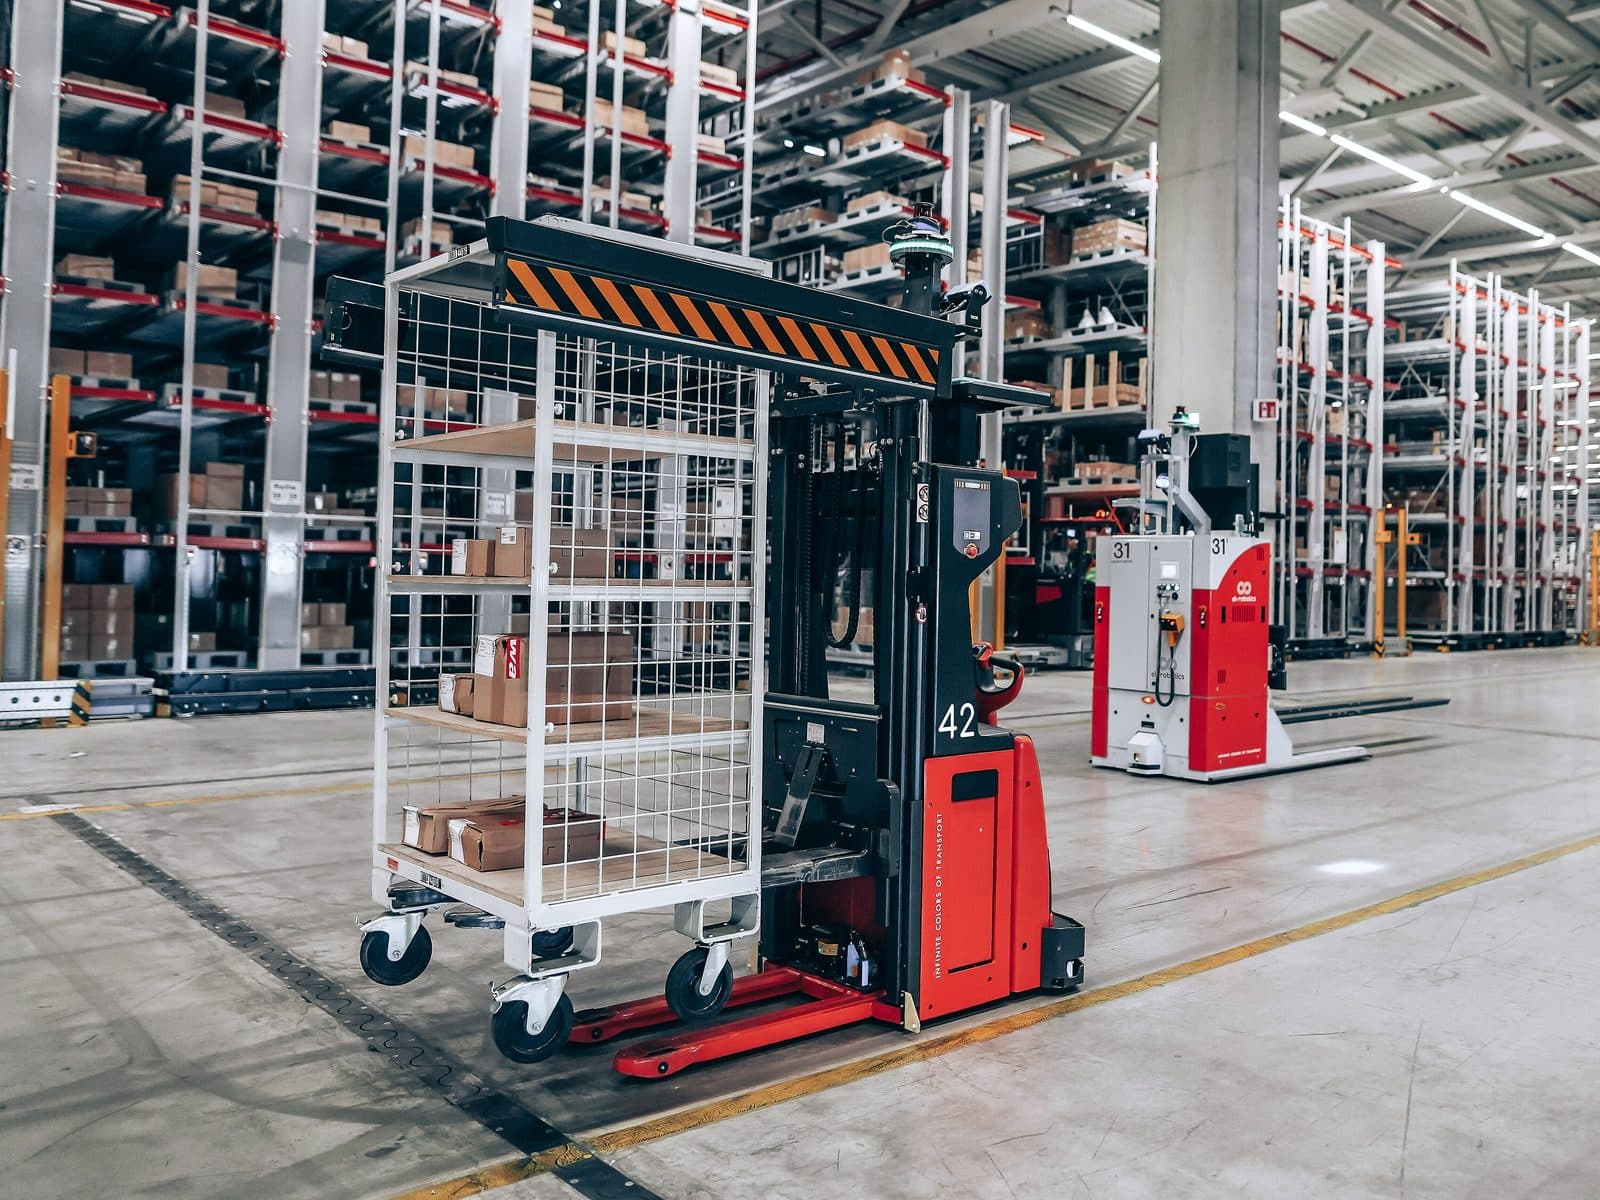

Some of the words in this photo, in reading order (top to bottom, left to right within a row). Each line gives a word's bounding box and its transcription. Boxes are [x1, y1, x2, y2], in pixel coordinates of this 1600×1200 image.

[1113, 541, 1130, 559] 31
[1212, 538, 1226, 555] 31
[1160, 672, 1185, 680] robtics
[938, 703, 976, 739] 42
[935, 875, 942, 888] OF
